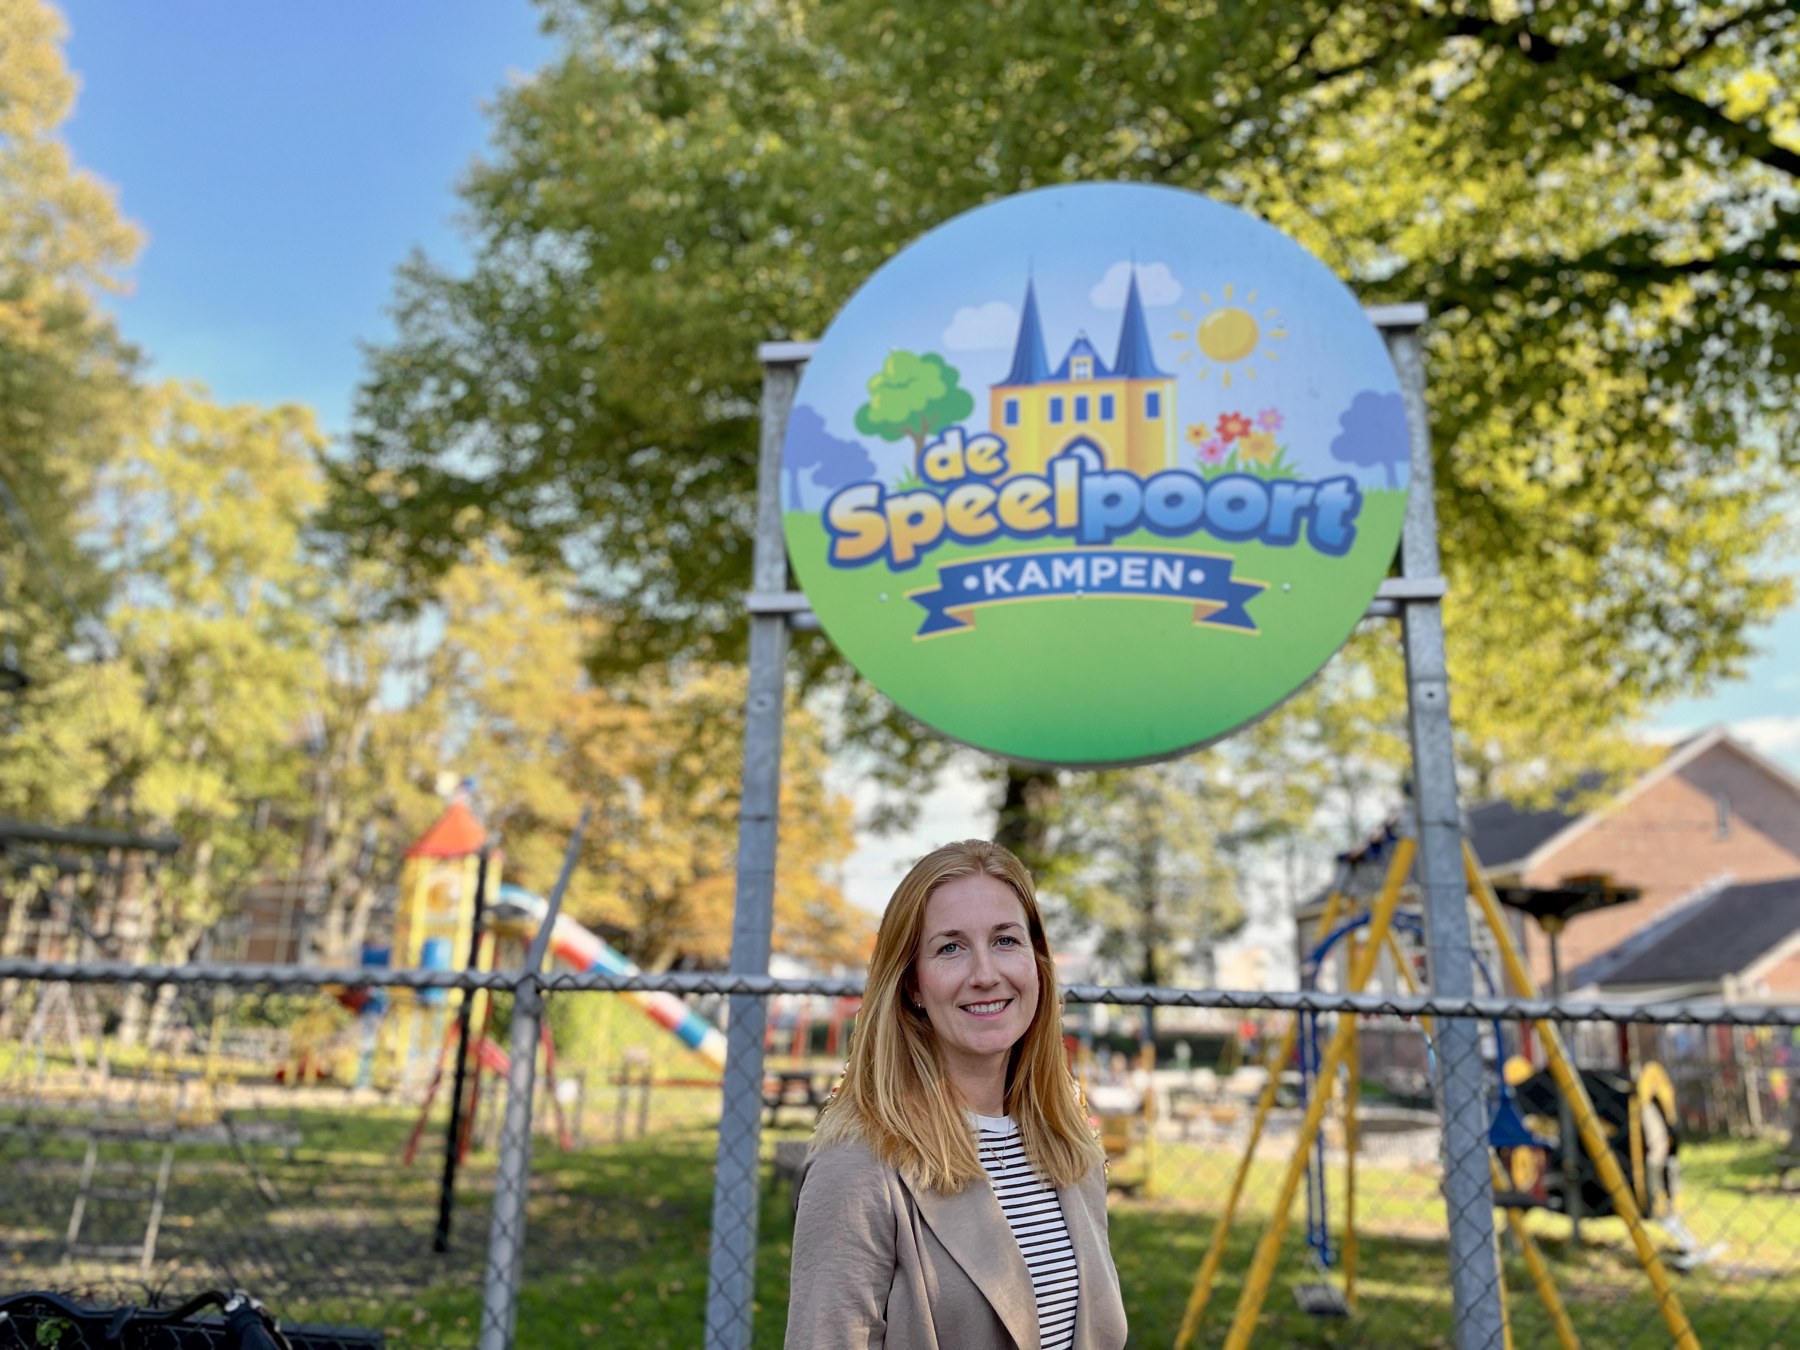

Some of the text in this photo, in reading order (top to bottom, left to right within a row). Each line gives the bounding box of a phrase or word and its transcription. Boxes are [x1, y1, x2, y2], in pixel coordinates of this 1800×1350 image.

[924, 429, 1003, 482] de
[826, 457, 1358, 567] Speelpoort
[982, 556, 1185, 595] KAMPEN
